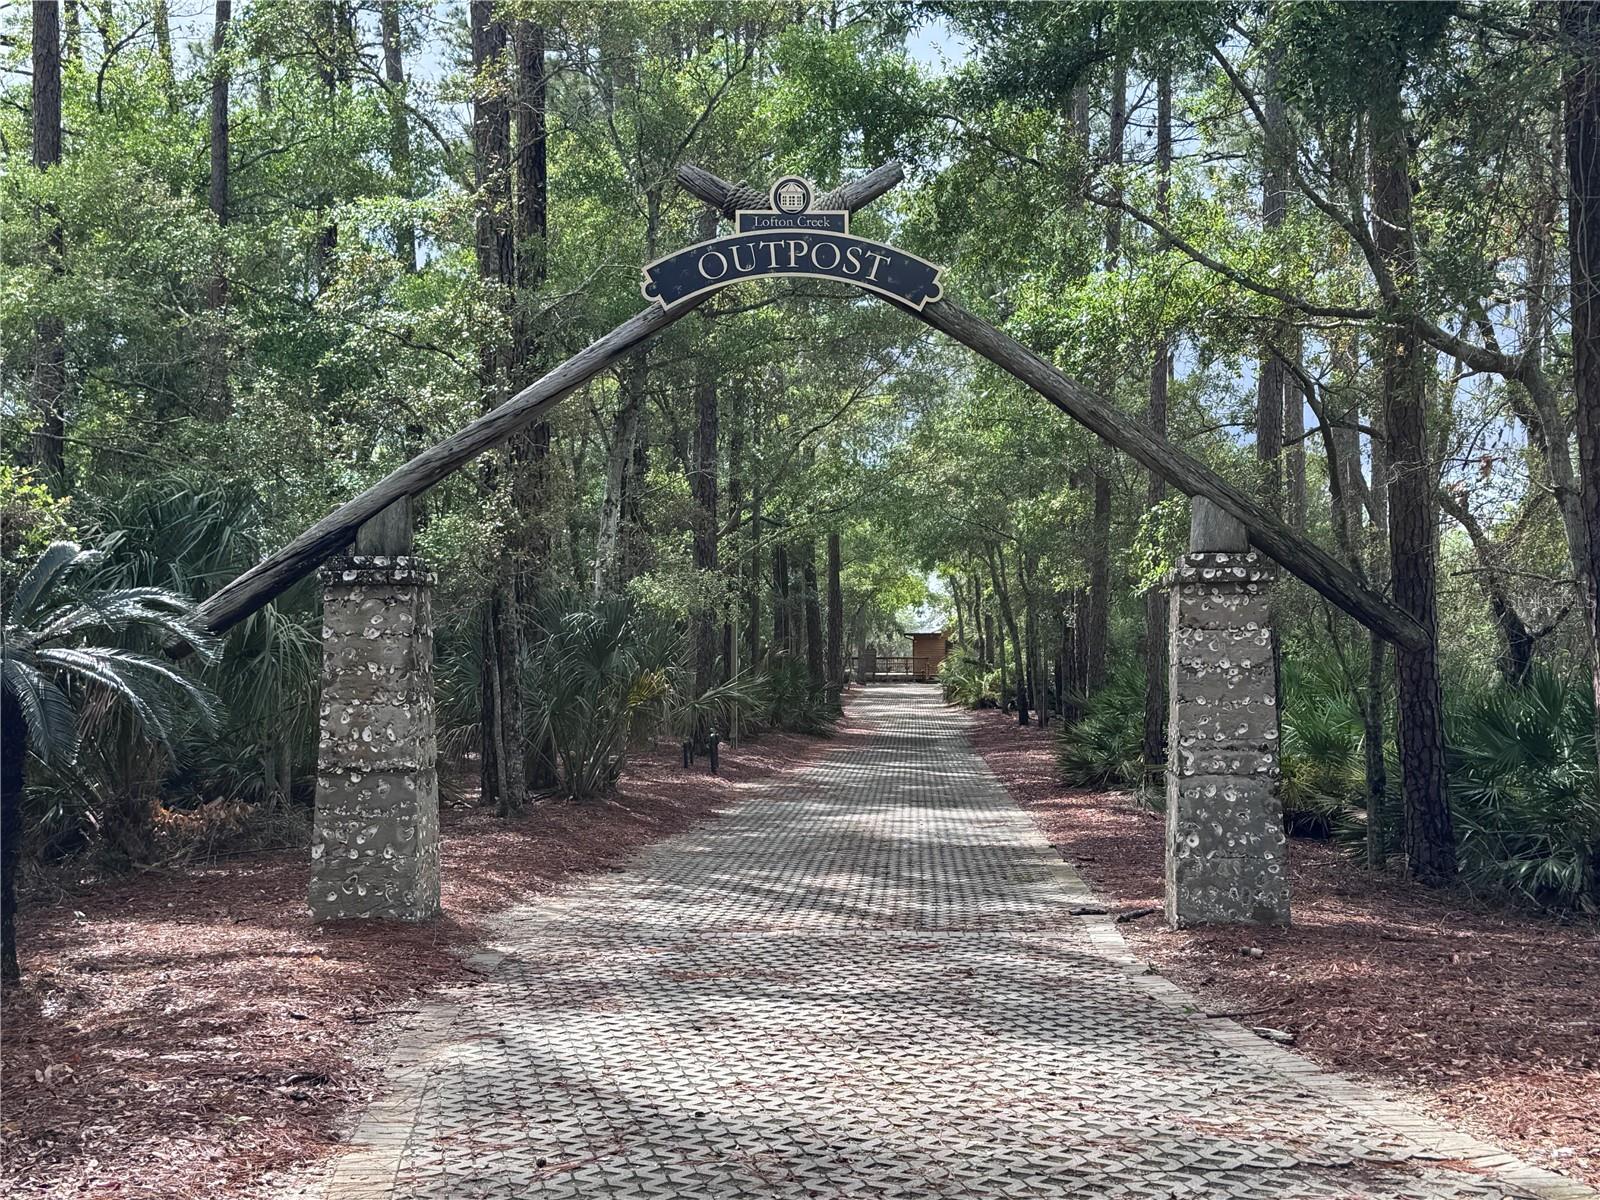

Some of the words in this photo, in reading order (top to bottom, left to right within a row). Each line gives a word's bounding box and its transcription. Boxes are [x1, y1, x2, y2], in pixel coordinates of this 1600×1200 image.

[754, 216, 793, 227] Lofton
[797, 216, 831, 227] Creek
[698, 239, 892, 282] OUTPOST
